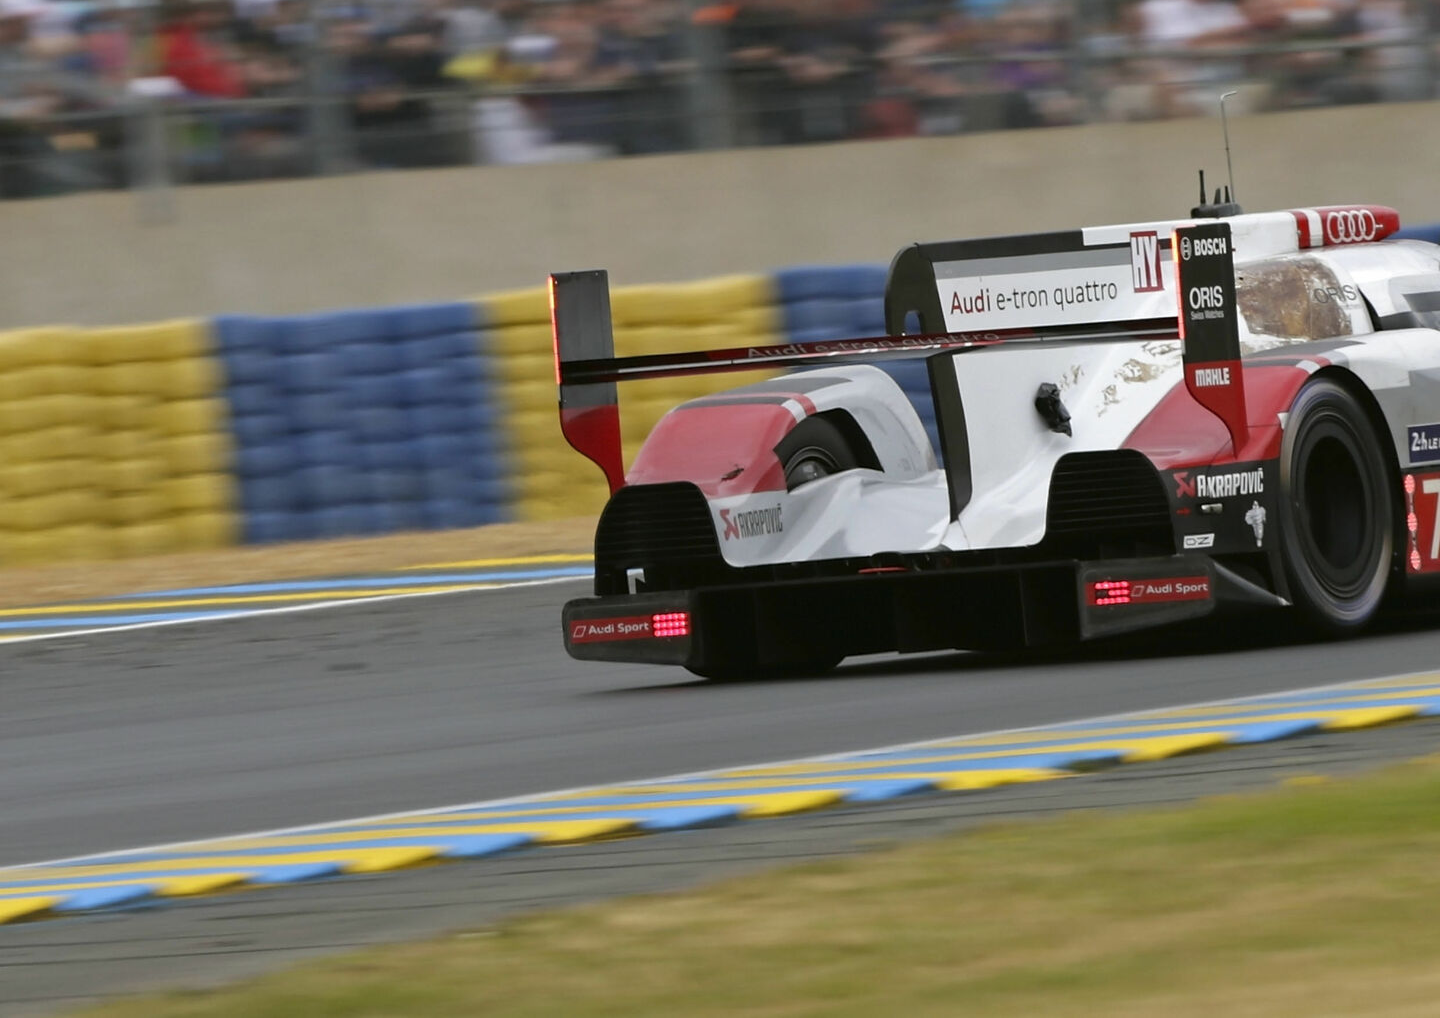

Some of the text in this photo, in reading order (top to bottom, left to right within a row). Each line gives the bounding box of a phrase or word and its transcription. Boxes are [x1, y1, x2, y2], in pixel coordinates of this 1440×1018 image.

[1194, 238, 1227, 256] BOSCH
[1130, 235, 1159, 288] HY
[950, 281, 1118, 315] Audi e-tron quattro
[1189, 286, 1224, 309] ORIS
[1313, 285, 1357, 303] ORIS
[747, 344, 807, 360] Audi
[1195, 368, 1230, 387] MAHLE
[1146, 583, 1208, 595] Audi Sport
[588, 621, 649, 635] Audi Sport
